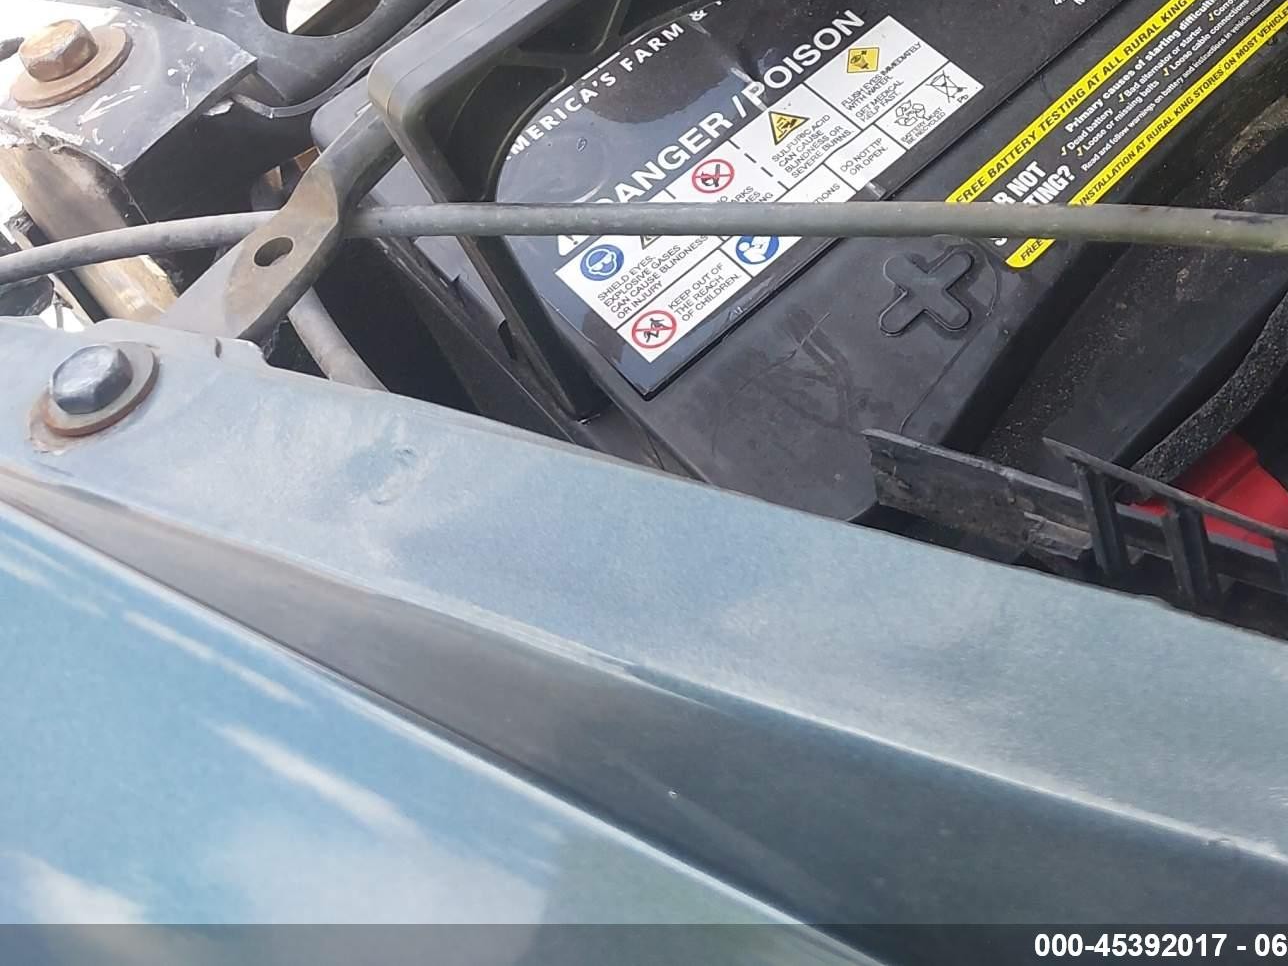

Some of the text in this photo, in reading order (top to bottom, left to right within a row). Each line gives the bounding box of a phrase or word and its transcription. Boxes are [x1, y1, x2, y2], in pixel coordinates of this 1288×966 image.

[840, 41, 921, 108] FLUSH EYES IMMEDIATELY
[1122, 25, 1202, 97] Bad alternator or starter
[1168, 49, 1193, 70] Loose
[1190, 33, 1211, 51] cable
[506, 71, 617, 160] MERICA'S
[619, 22, 685, 72] FARM
[843, 93, 867, 111] WITH
[854, 79, 904, 119] GET MEDICAL
[956, 93, 969, 103] Pb
[1064, 97, 1103, 132] Primary
[1101, 69, 1135, 99] causes
[1134, 58, 1146, 70] of
[1144, 29, 1181, 61] starting
[1080, 152, 1100, 171] Read
[1097, 142, 1112, 156] and
[1108, 125, 1129, 145] follow
[1127, 102, 1156, 128] warnings
[1153, 94, 1164, 103] on
[1159, 76, 1184, 96] battery
[1181, 65, 1195, 78] and
[1191, 37, 1227, 68] instructions
[1222, 31, 1232, 39] in
[1229, 14, 1251, 33] vehicle
[770, 113, 831, 162] SULFURIC ACID
[858, 104, 880, 123] HELP
[899, 119, 929, 142] BATTERY
[902, 111, 946, 145] BE RECYCLED
[955, 175, 987, 206] FREE
[986, 129, 1036, 179] BATTERY
[1037, 87, 1086, 132] TESTING
[1086, 72, 1100, 90] AT
[1101, 55, 1124, 76] ALL
[1122, 22, 1161, 56] RURAL
[1065, 107, 1113, 150] Dead battery
[1081, 79, 1160, 151] Loose or missing belts
[595, 111, 734, 203] ANGER
[778, 128, 824, 167] CAN CAUSE
[781, 124, 844, 173] BLINDNESS OR
[788, 128, 854, 178] SEVERE BURNS.
[839, 137, 882, 172] DO NOT TIP
[848, 145, 888, 175] OR OPEN.
[1019, 237, 1043, 261] FREE
[1078, 149, 1136, 206] INSTALLATION
[1135, 139, 1146, 153] AT
[1145, 115, 1175, 143] RURAL
[1172, 95, 1194, 117] KING
[1192, 66, 1224, 98] STORES
[1223, 56, 1237, 70] ON
[1234, 34, 1258, 59] MOST
[1005, 160, 1046, 197] NOT
[596, 273, 630, 301] SHIELD
[602, 244, 681, 307] EXPLOSIVE GASES
[609, 235, 877, 313] CAN CAUSE BLINDNESS
[667, 261, 723, 310] KEEP OUT OF
[673, 274, 724, 315] THE REACH
[680, 273, 739, 321] OF CHILDREN.
[616, 279, 662, 319] OR INJURY
